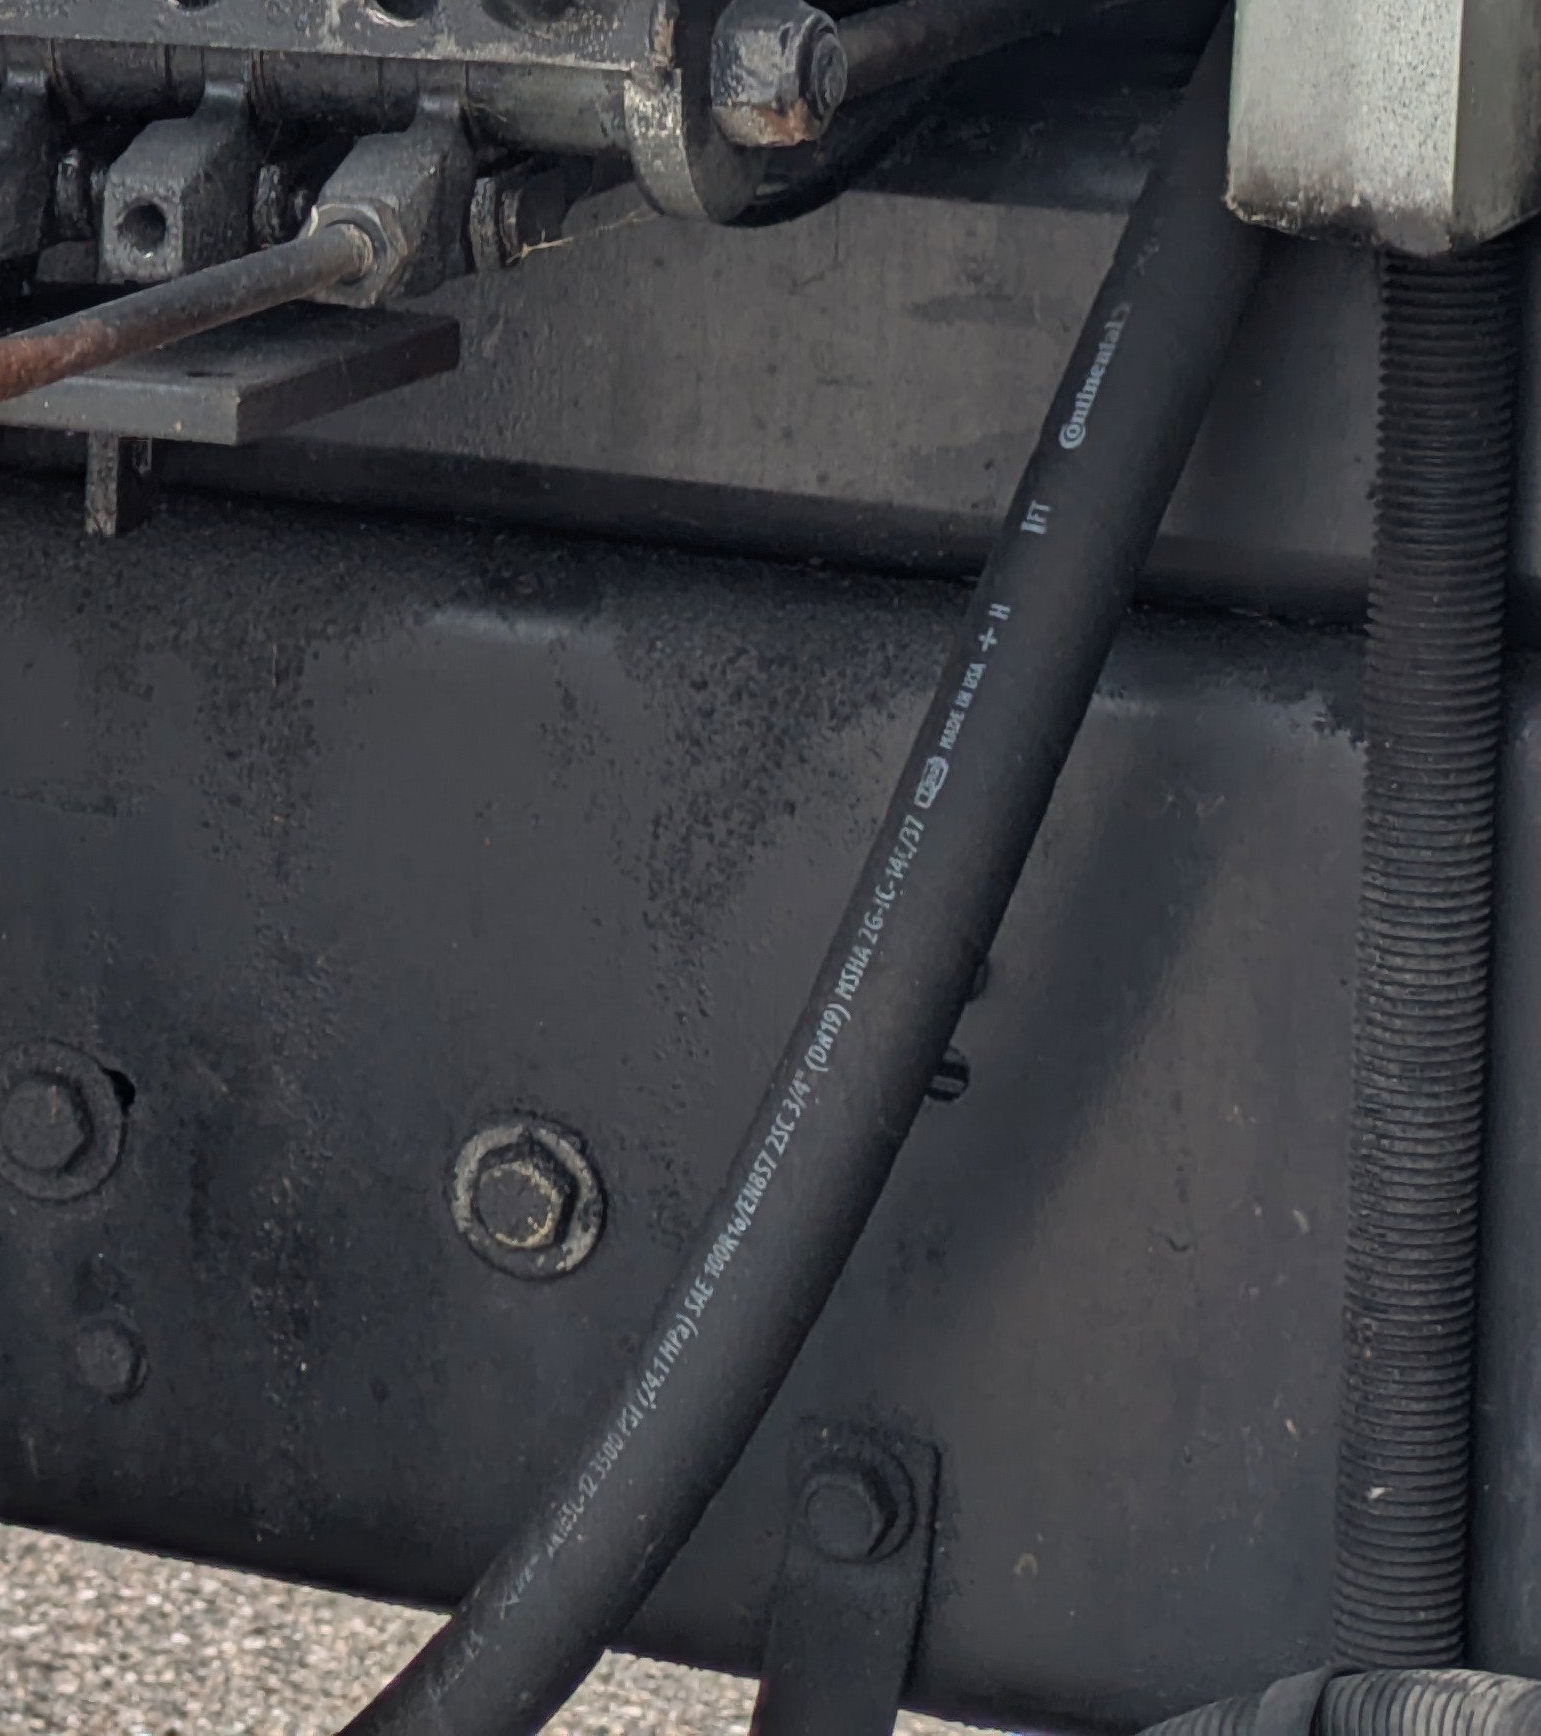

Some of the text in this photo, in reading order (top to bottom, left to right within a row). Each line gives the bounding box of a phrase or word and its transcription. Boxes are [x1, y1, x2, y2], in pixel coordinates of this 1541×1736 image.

[684, 1276, 714, 1317] SAE
[765, 1113, 795, 1157] 2SC
[834, 945, 872, 1001] MSHA
